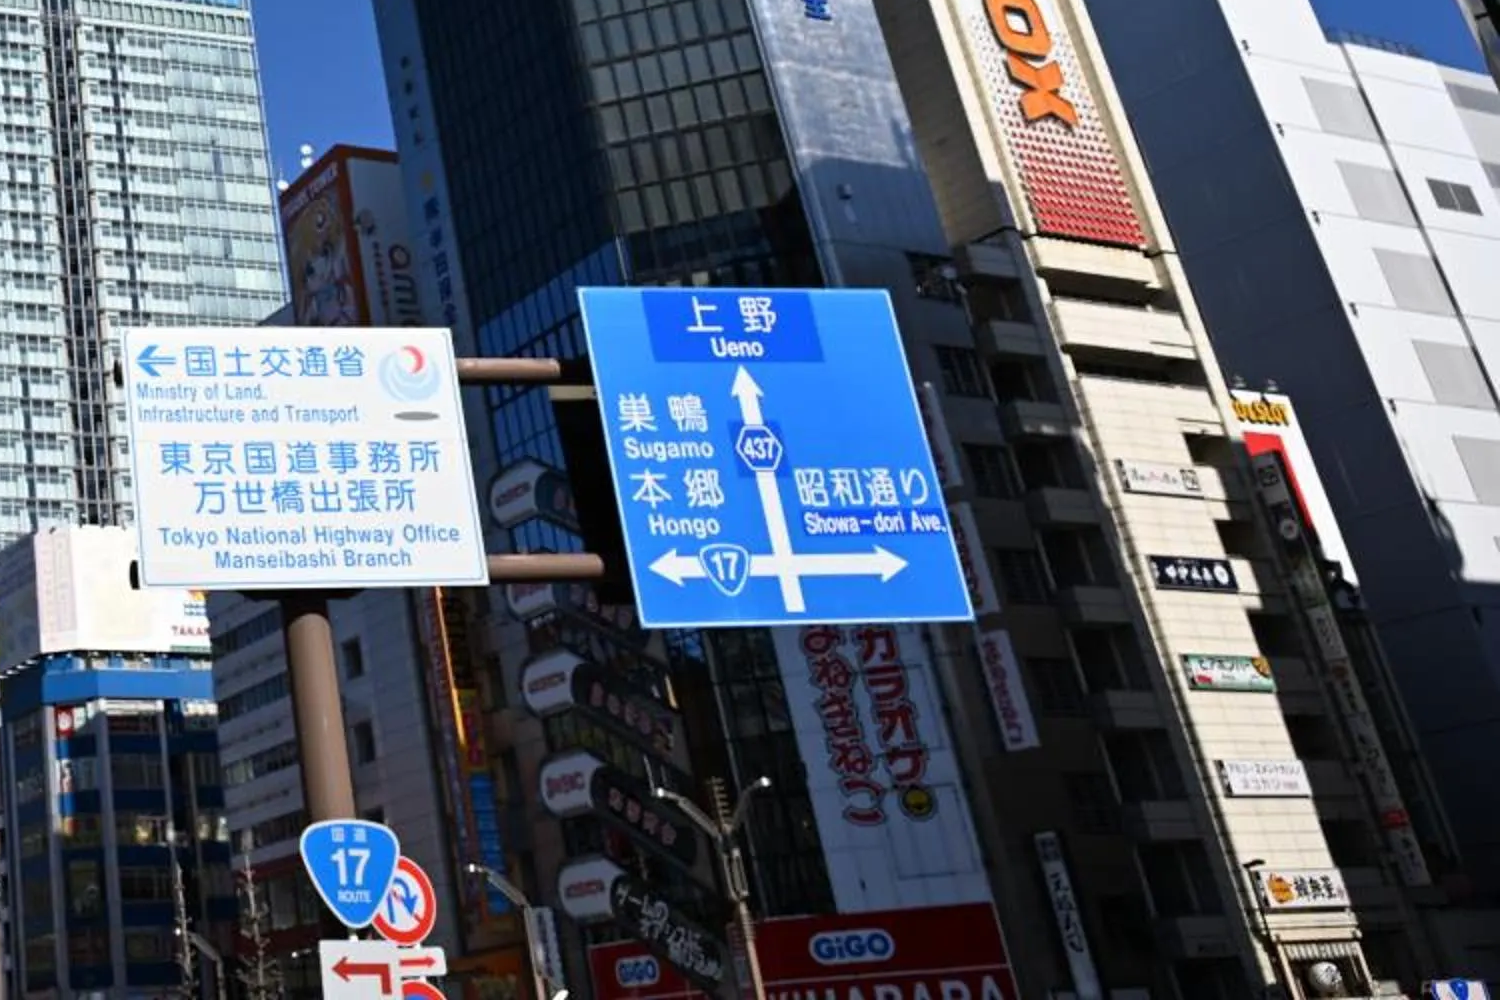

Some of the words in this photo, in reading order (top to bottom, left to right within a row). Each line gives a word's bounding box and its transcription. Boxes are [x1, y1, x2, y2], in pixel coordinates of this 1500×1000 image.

[686, 295, 777, 335] 上野
[710, 337, 765, 358] Ueno
[184, 344, 365, 378] 国土交通省
[136, 383, 197, 403] Ministry
[204, 383, 219, 399] of
[138, 405, 245, 422] Infrastructure
[251, 405, 278, 422] and
[284, 404, 359, 426] Transport
[617, 393, 709, 433] 巣鴨
[159, 440, 441, 475] 東京国道事務所
[624, 437, 715, 462] Sugamo
[742, 437, 775, 460] 437
[193, 478, 417, 515] 万世橋出張所
[629, 468, 726, 509] 本郷
[793, 467, 930, 508] 昭和通り
[158, 527, 218, 549] Tokyo
[226, 525, 307, 544] National
[313, 524, 394, 548] Highway
[402, 523, 461, 542] Office
[649, 514, 721, 539] Hongo
[803, 512, 905, 534] Showa-dori
[911, 512, 948, 533] Ave.
[215, 549, 337, 569] Manseibashi
[343, 549, 412, 568] Branch
[710, 551, 740, 580] 17
[331, 848, 371, 886] 17
[337, 890, 371, 905] ROUTE
